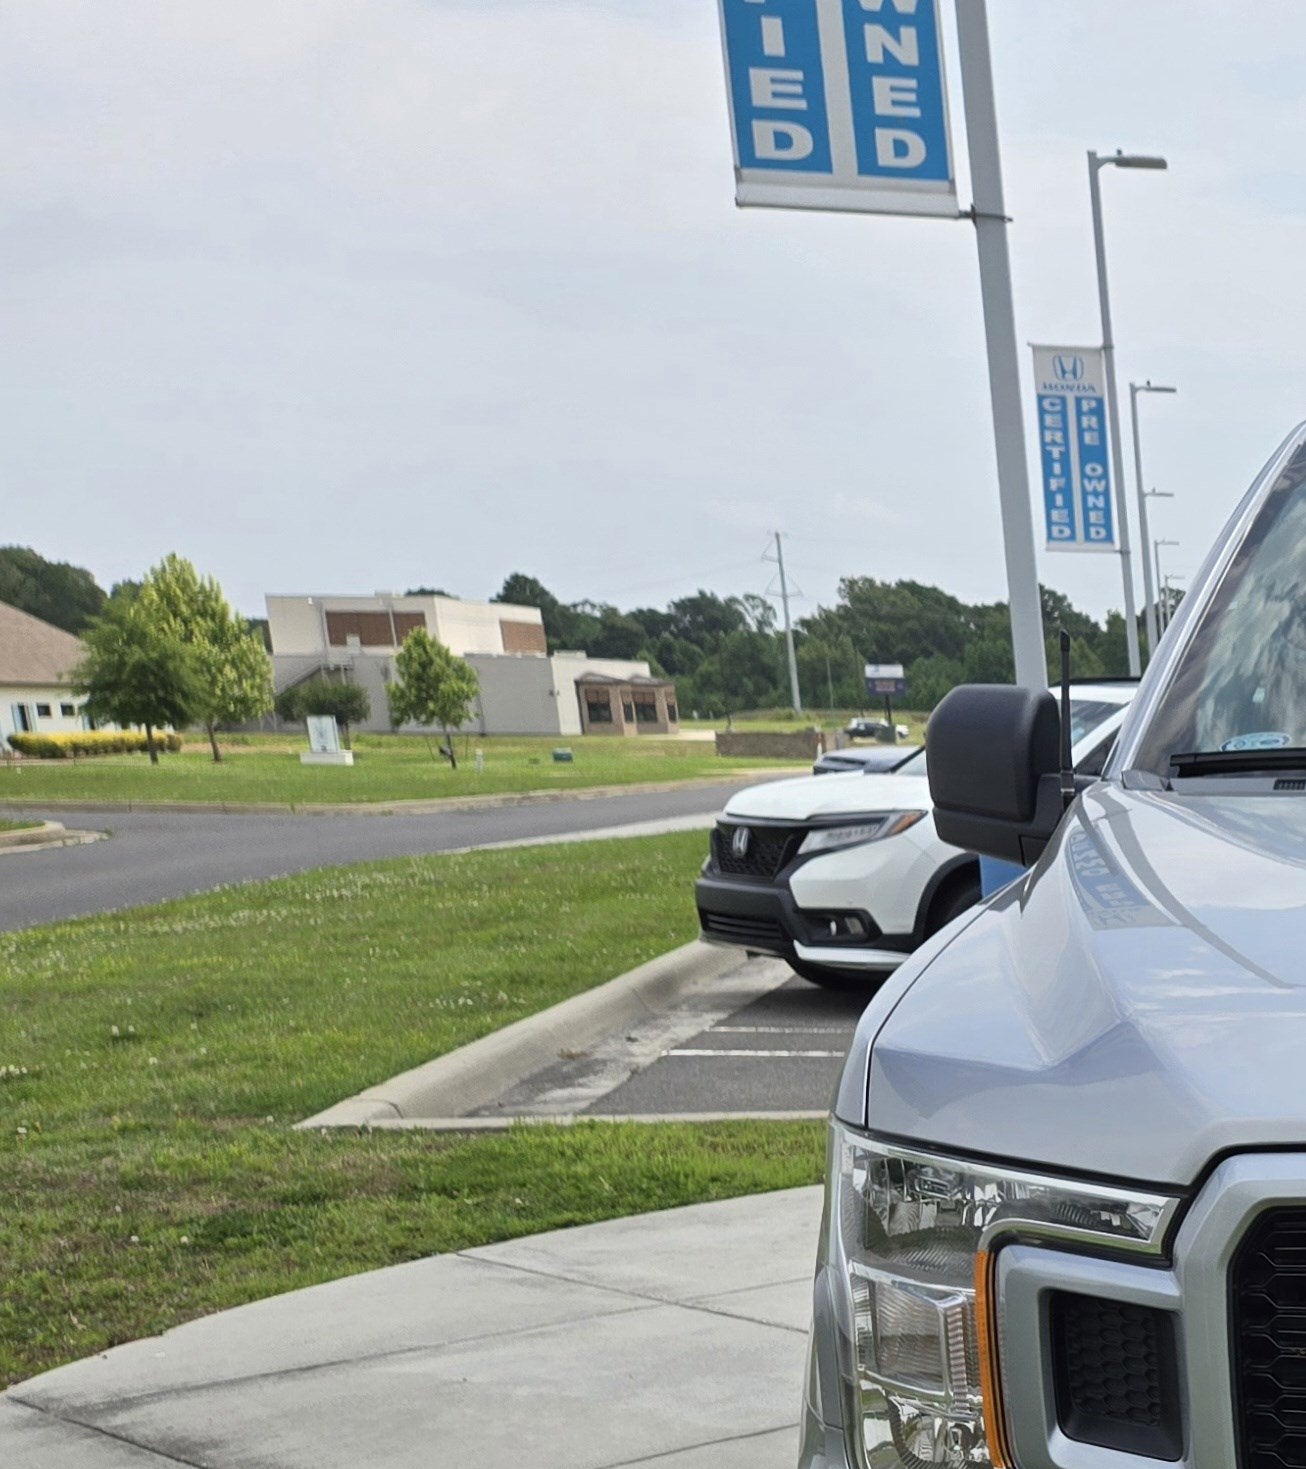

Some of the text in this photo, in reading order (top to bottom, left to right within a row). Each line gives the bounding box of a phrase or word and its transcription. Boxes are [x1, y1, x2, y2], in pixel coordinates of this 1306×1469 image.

[1042, 397, 1072, 539] CERTIFIED
[1081, 399, 1107, 540] PRE OWNED
